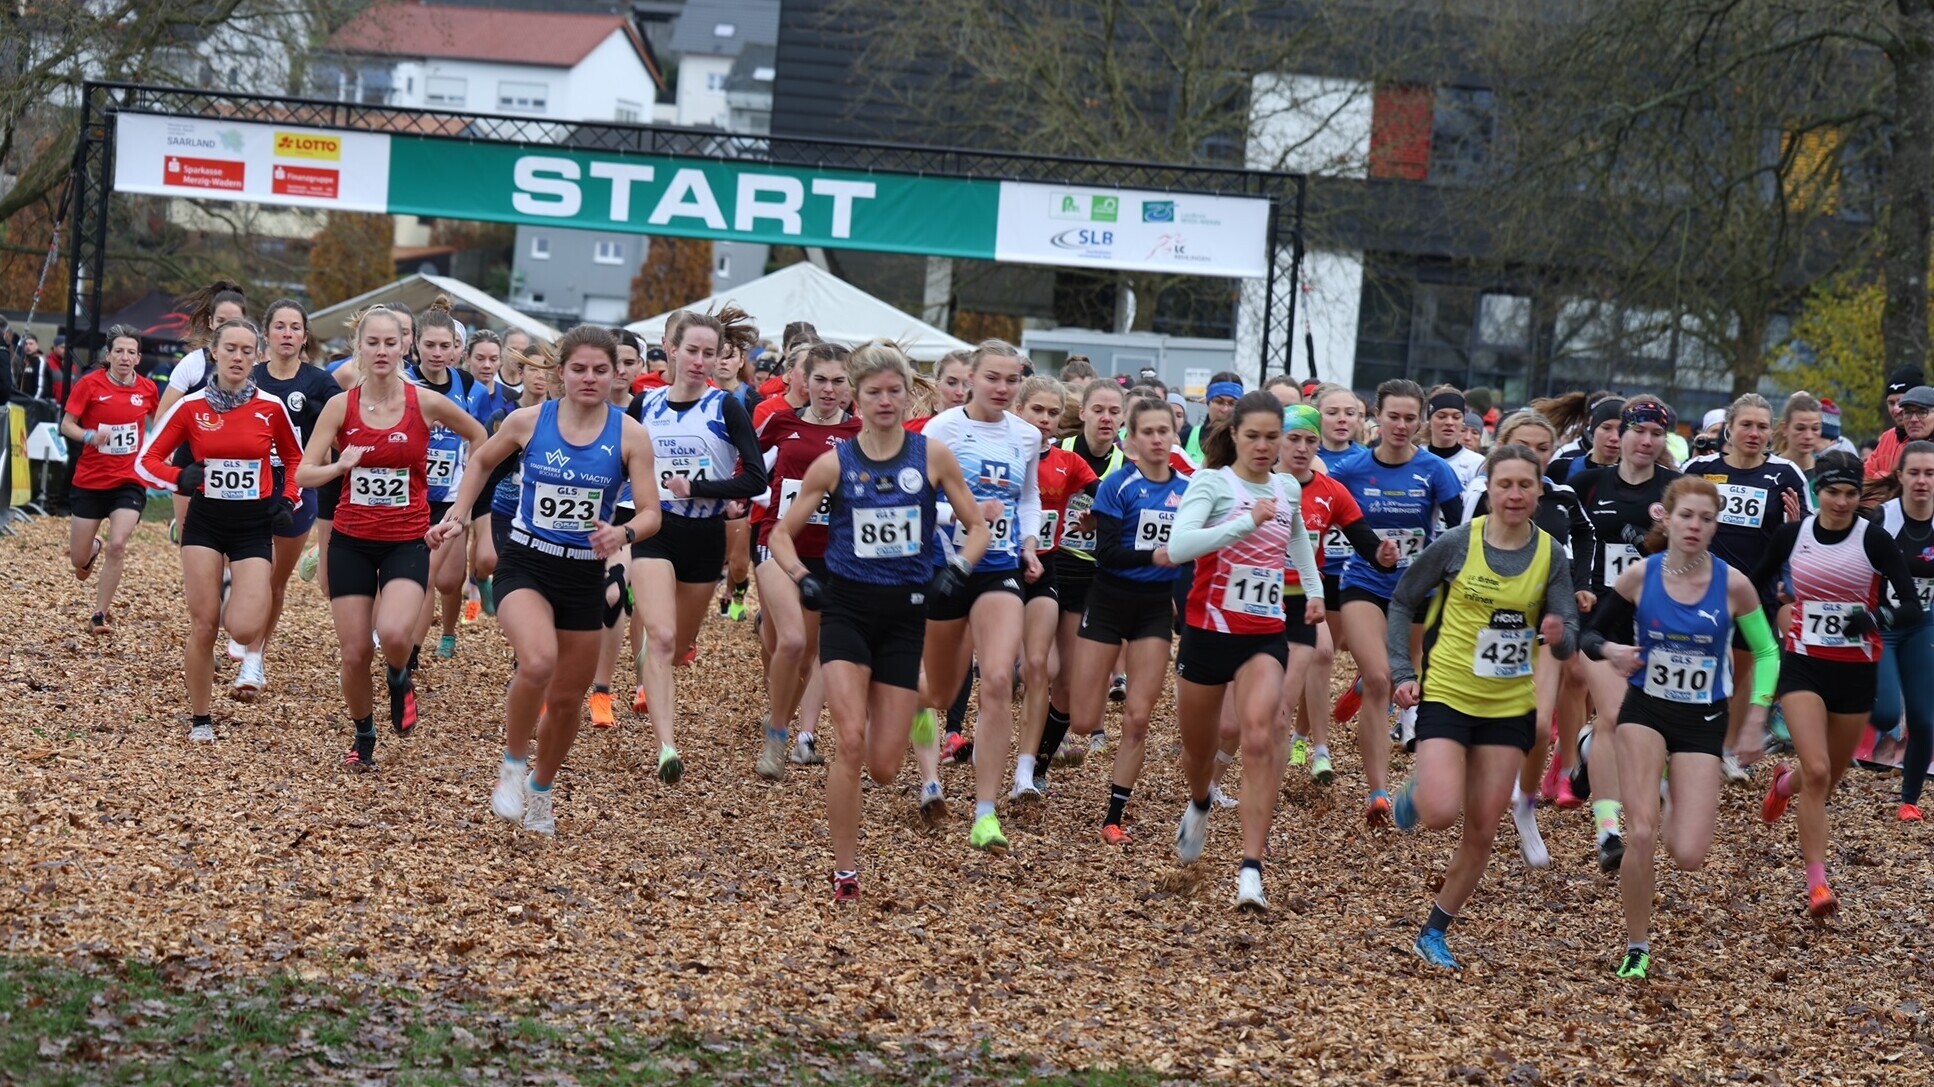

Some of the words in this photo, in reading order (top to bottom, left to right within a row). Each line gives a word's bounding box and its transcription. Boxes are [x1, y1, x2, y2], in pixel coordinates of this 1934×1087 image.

[167, 136, 216, 148] SAARLAND
[296, 138, 337, 152] LOTTO
[183, 165, 223, 176] Sparkasse
[183, 175, 242, 188] Merzig-Wadern
[512, 155, 877, 239] START
[1079, 229, 1114, 245] SLB
[195, 412, 210, 421] LG
[658, 439, 676, 447] TUS
[670, 446, 696, 455] KÖLN
[223, 460, 241, 468] GLS
[530, 462, 561, 473] STADTWERKE
[672, 458, 690, 466] GLS
[210, 470, 255, 489] 505
[539, 470, 561, 478] BOCHUM
[580, 472, 612, 484] VIACTIV
[356, 477, 404, 496] 332
[557, 487, 578, 496] GLS
[1729, 485, 1747, 494] GLS
[540, 497, 595, 521] 923
[1158, 512, 1175, 520] GLS
[861, 521, 912, 544] 861
[530, 537, 565, 557] PUMA
[1234, 578, 1280, 605] 116
[1493, 613, 1524, 623] HOKA
[1481, 642, 1529, 664] 425
[1652, 664, 1707, 691] 310
